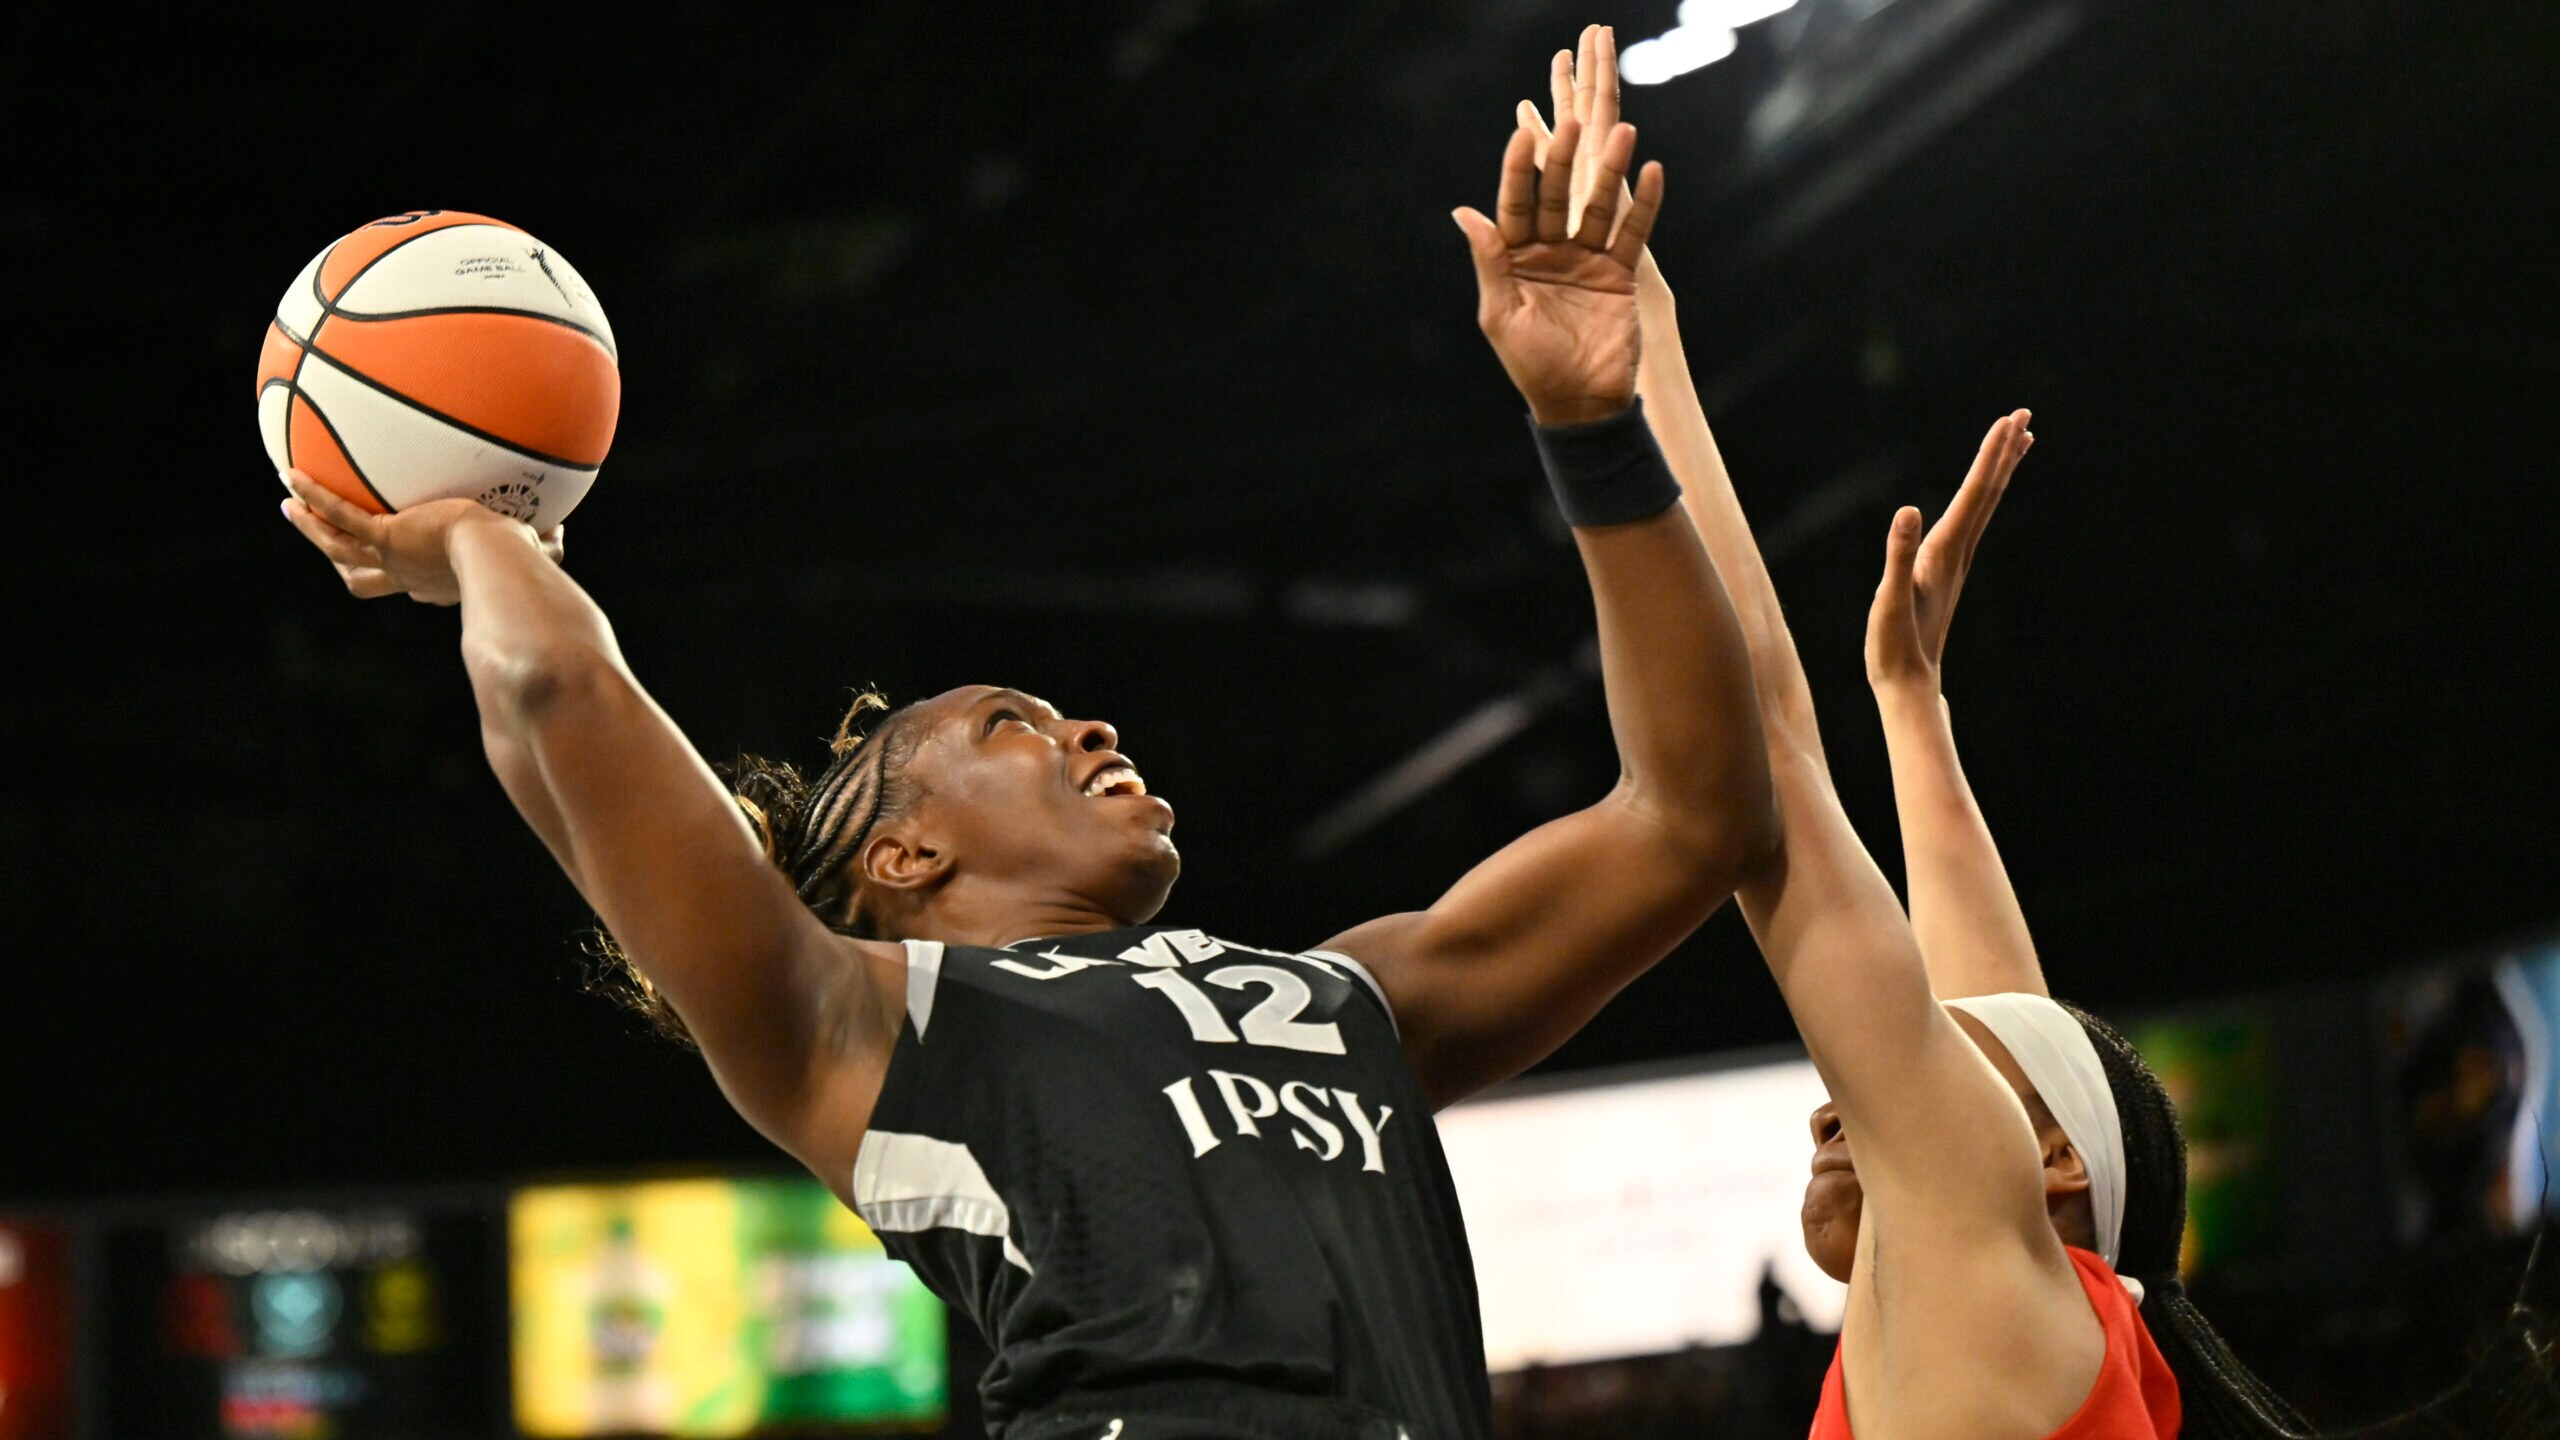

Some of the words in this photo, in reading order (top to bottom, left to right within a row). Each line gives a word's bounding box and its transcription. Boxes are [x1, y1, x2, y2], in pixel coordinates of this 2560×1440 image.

[455, 265, 494, 275] GAME
[496, 264, 527, 273] BALL
[1131, 966, 1348, 1056] 12
[1162, 1069, 1394, 1175] IPSY
